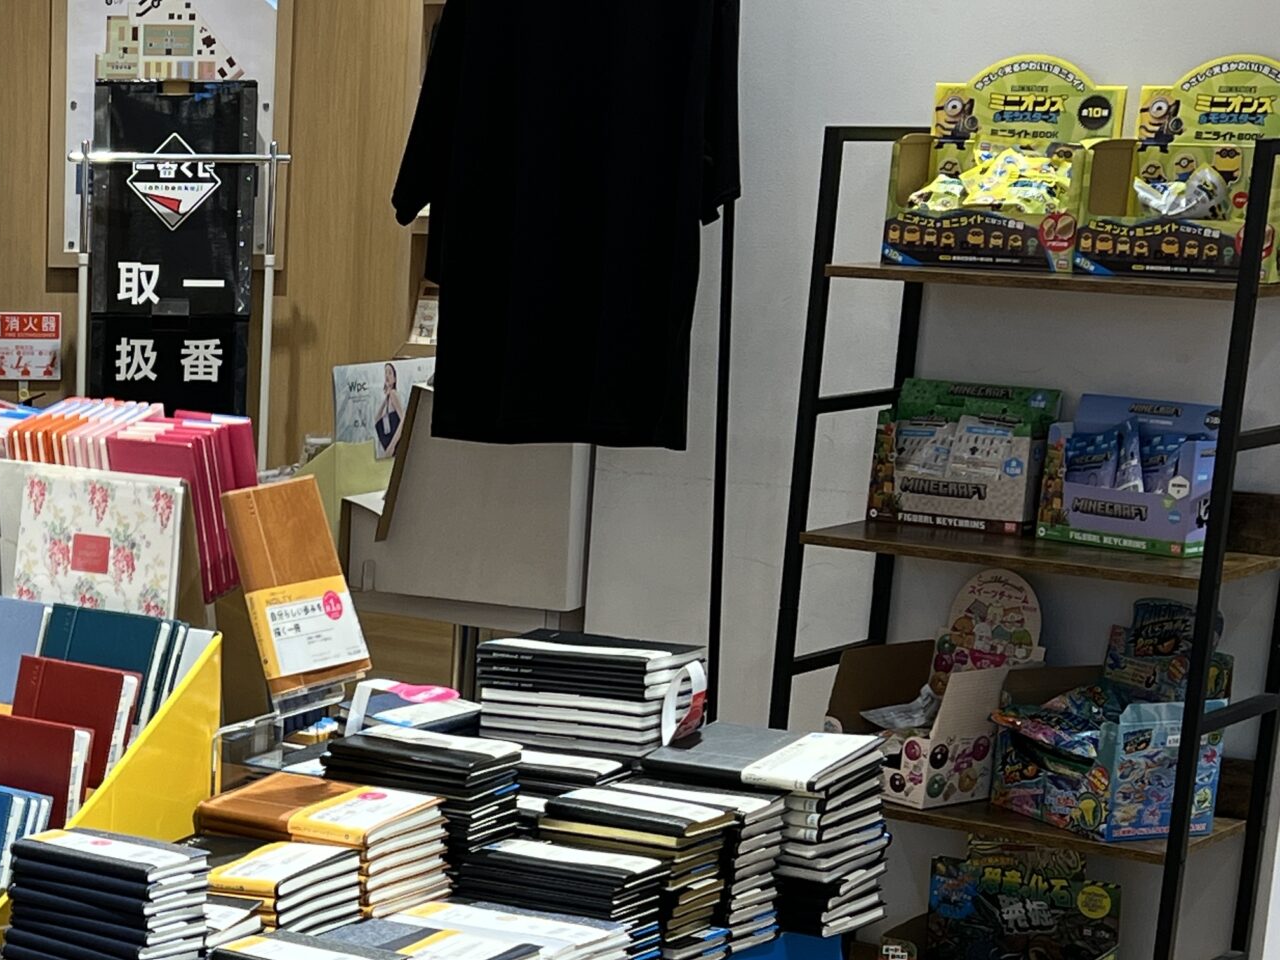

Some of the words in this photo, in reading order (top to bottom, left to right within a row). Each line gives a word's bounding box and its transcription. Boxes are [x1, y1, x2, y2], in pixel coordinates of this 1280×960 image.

[989, 93, 1069, 113] ミニオンズ
[1195, 94, 1277, 113] ミニオンズ
[4, 315, 57, 333] 消火器
[949, 384, 1014, 400] MINECRAFT
[1128, 402, 1184, 418] MINECRAFT
[900, 476, 988, 501] MINECRAFT
[1071, 497, 1148, 522] MINECRAFT
[934, 516, 986, 531] KEYCHAINS
[270, 602, 322, 622] 自分らしい歩みを
